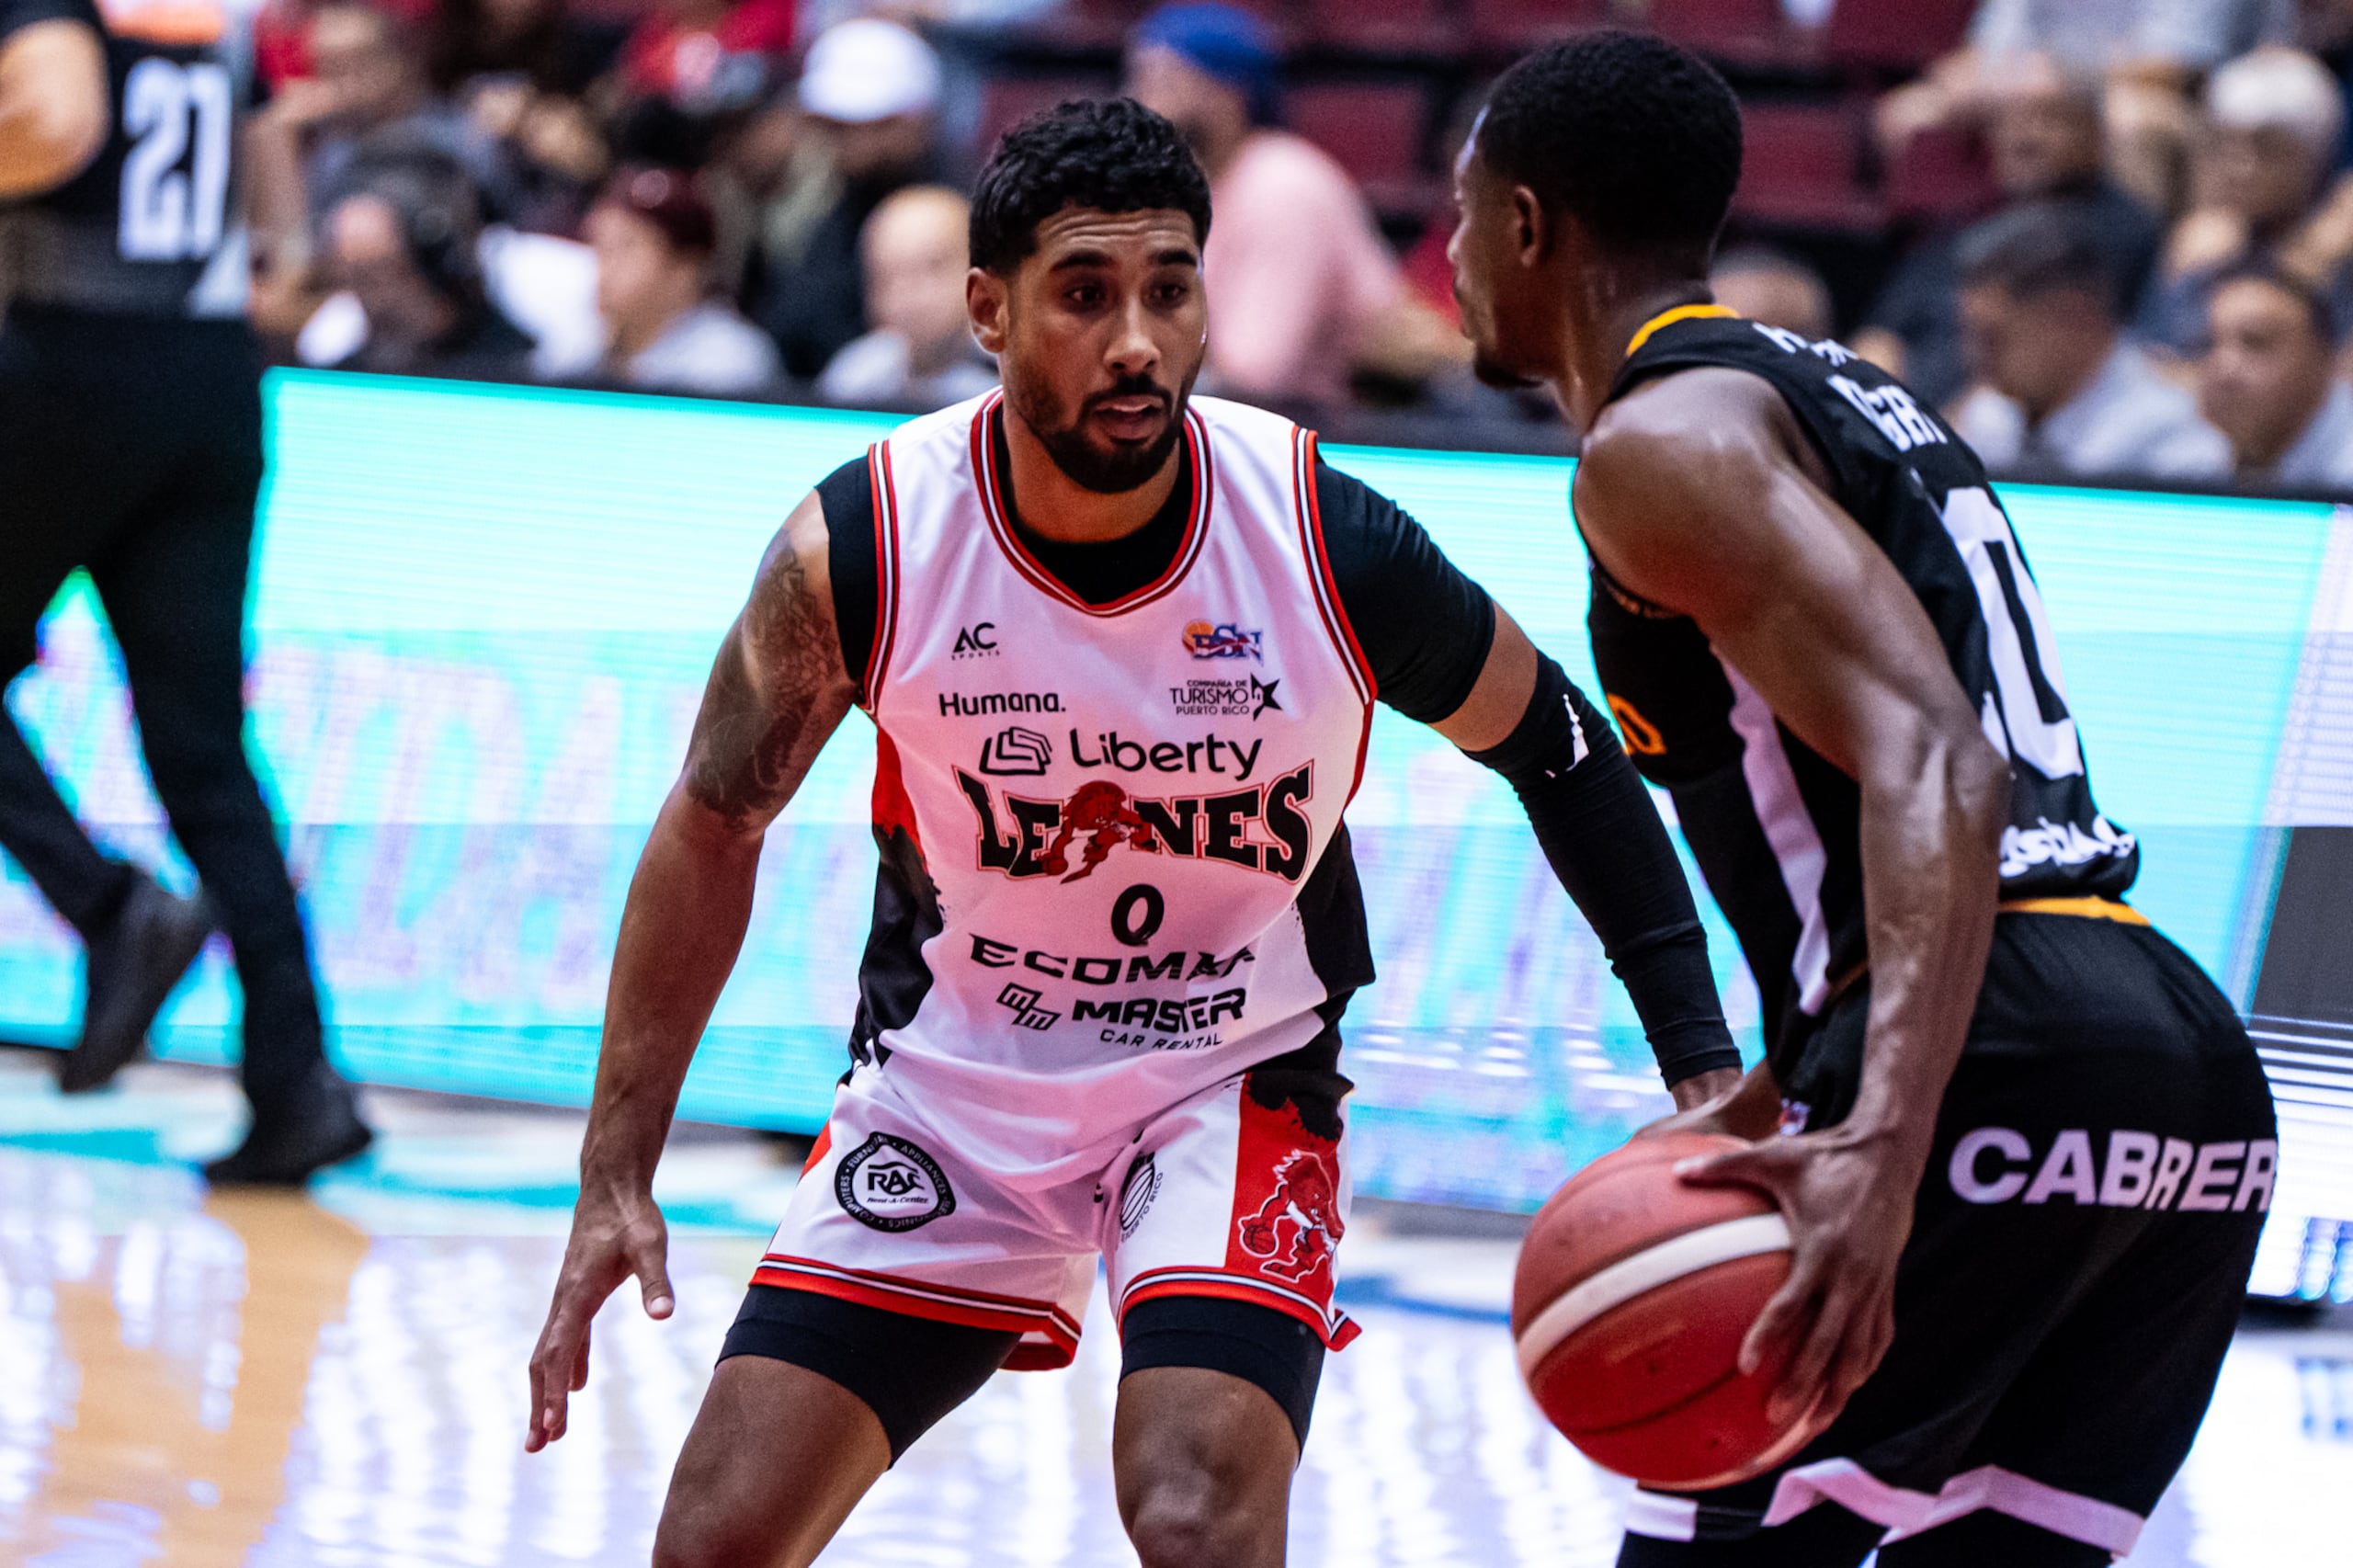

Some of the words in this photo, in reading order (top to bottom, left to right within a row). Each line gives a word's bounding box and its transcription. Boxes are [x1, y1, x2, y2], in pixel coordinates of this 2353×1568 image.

[952, 622, 997, 653] AC
[938, 692, 1066, 717] Humana.
[1169, 687, 1248, 705] TURISMO
[1176, 706, 1218, 715] PUERTO
[1222, 706, 1249, 715] RICO
[1069, 728, 1263, 781] Liberty
[1111, 883, 1165, 947] 0
[1072, 988, 1246, 1034] MASTER
[1100, 1029, 1145, 1047] CAR
[1153, 1033, 1222, 1050] RENTAL
